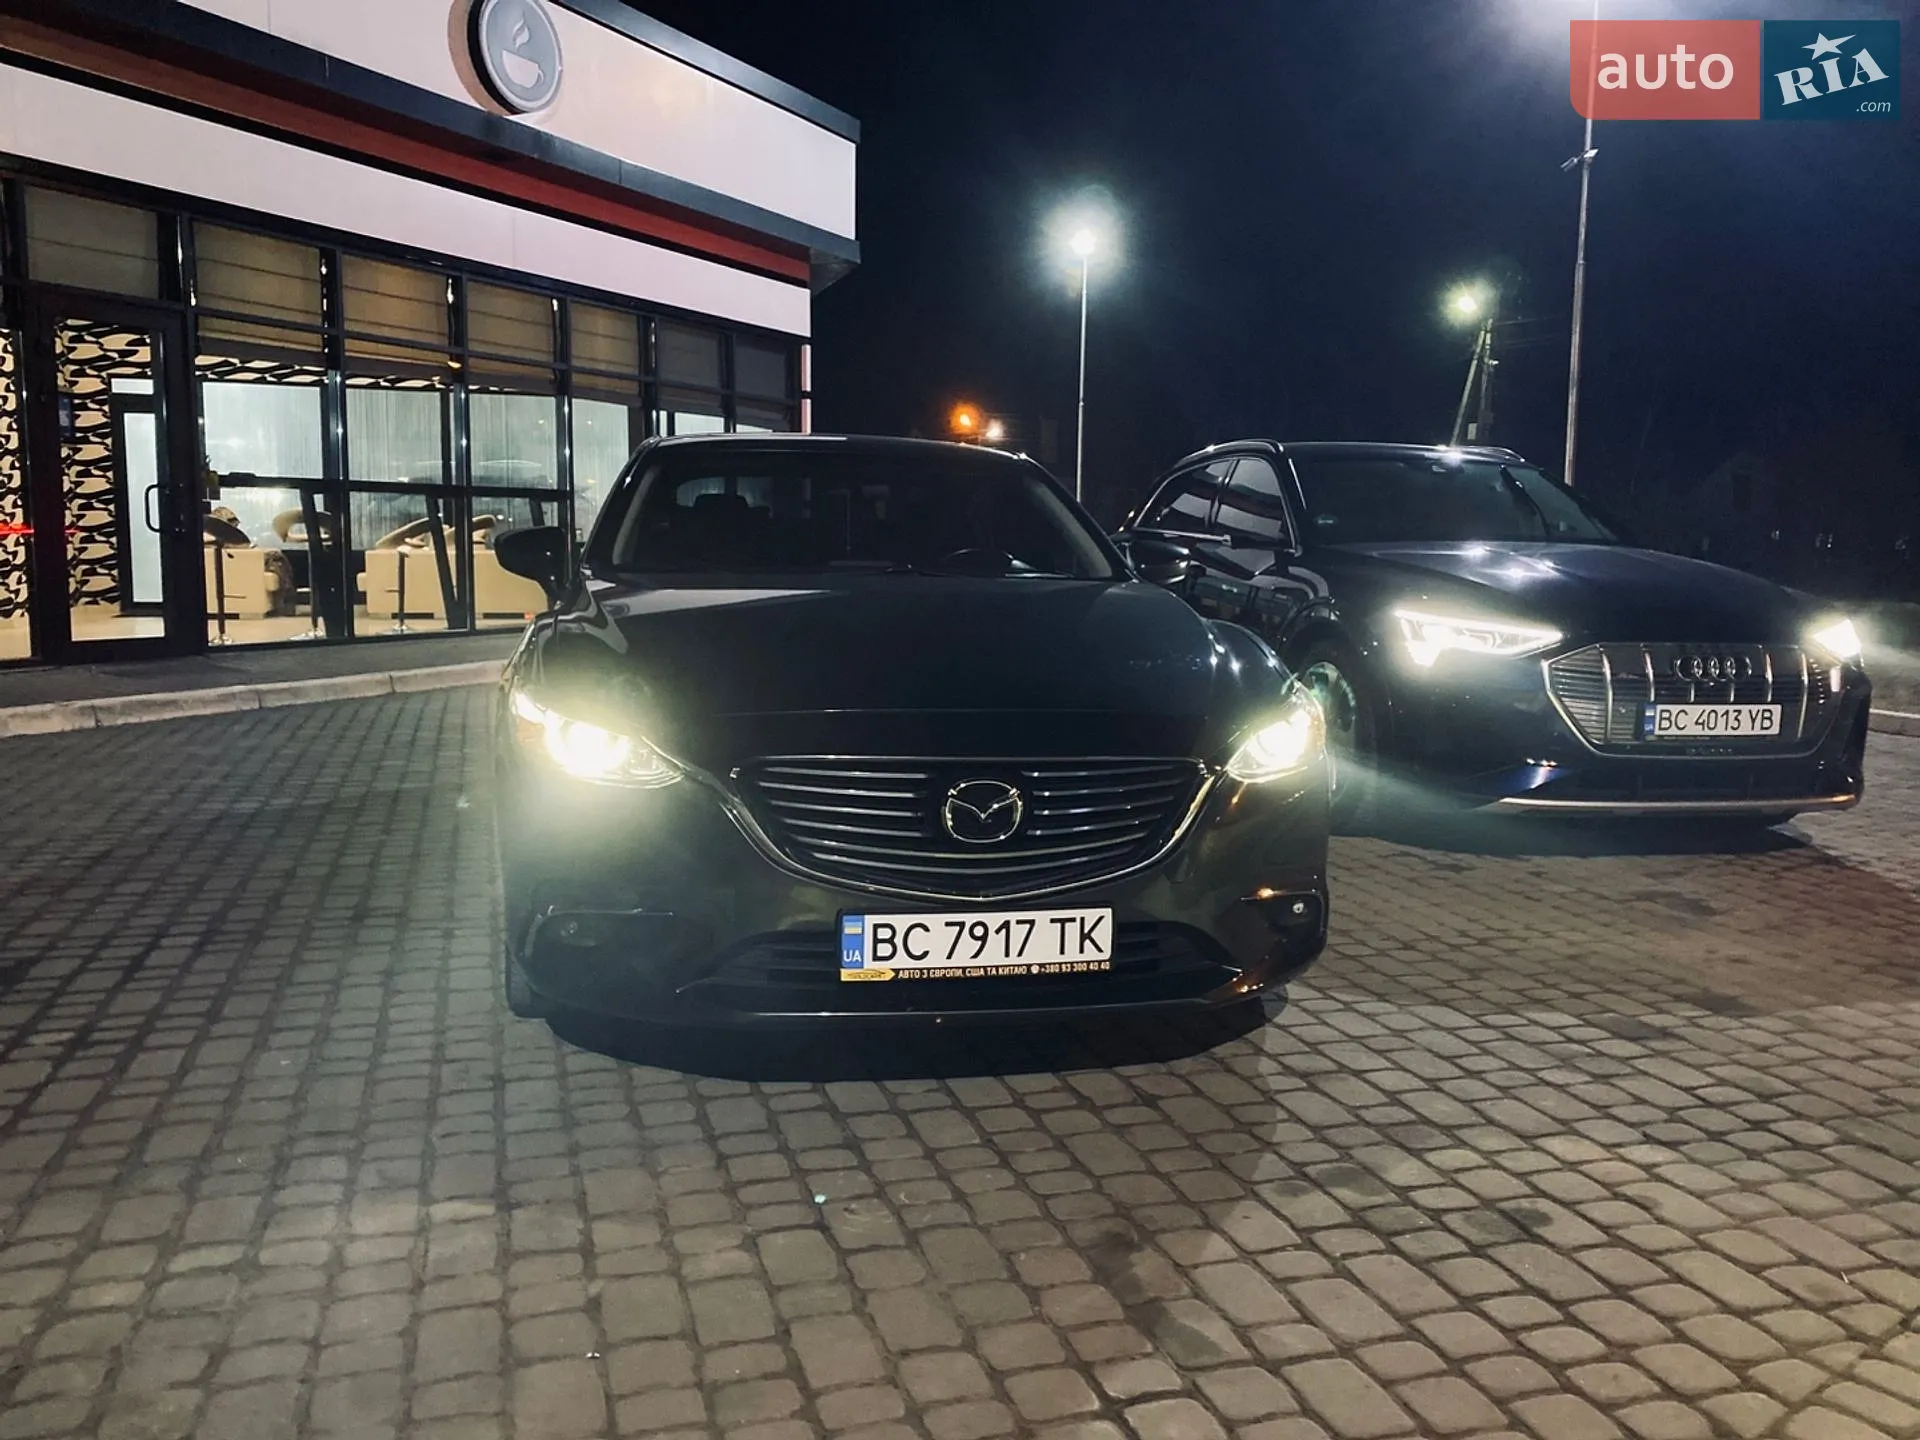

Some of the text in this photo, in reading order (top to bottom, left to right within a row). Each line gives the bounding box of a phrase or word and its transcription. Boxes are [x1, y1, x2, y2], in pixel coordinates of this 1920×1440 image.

[1658, 708, 1774, 731] BC 4013 YB
[871, 914, 1105, 962] BC 7917 TK
[843, 949, 861, 963] UA
[898, 969, 920, 979] АВТО
[965, 967, 985, 977] США
[986, 967, 996, 976] ТА
[998, 966, 1027, 976] КИТАЮ
